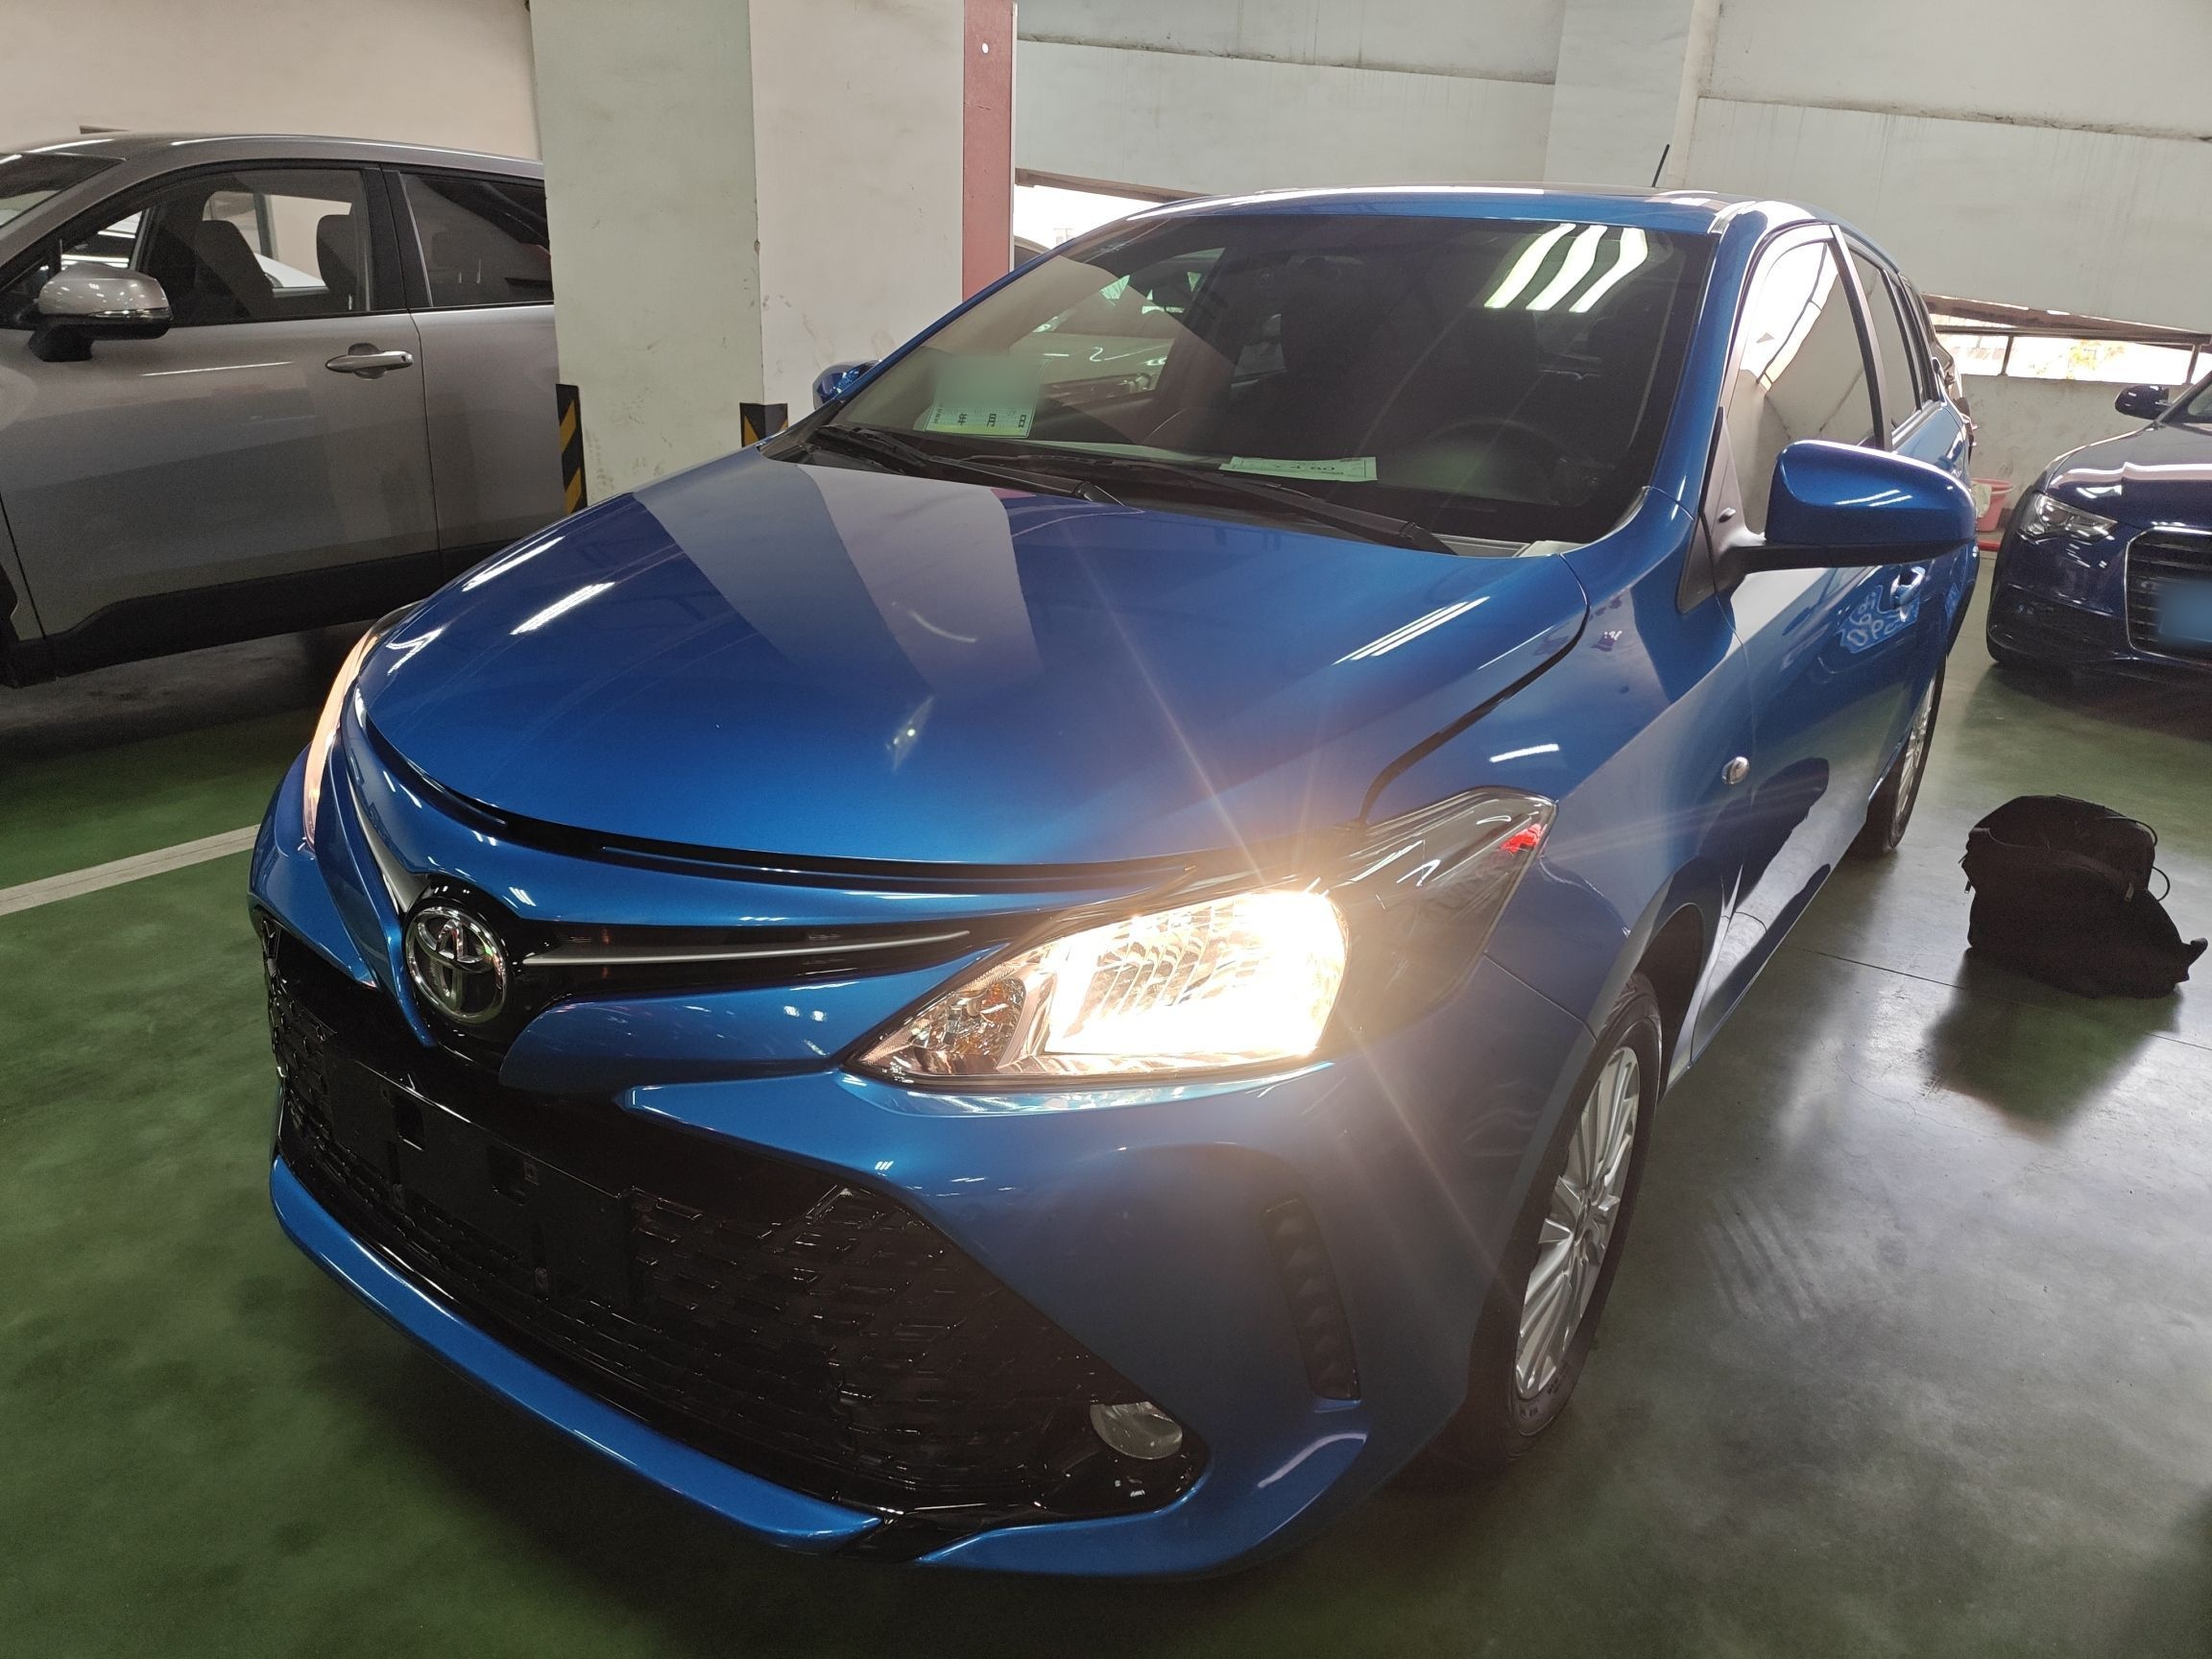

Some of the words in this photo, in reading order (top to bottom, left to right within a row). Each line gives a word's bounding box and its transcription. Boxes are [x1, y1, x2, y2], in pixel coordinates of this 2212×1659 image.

[957, 413, 968, 426] 年
[986, 413, 998, 427] 月
[1018, 414, 1027, 428] 日
